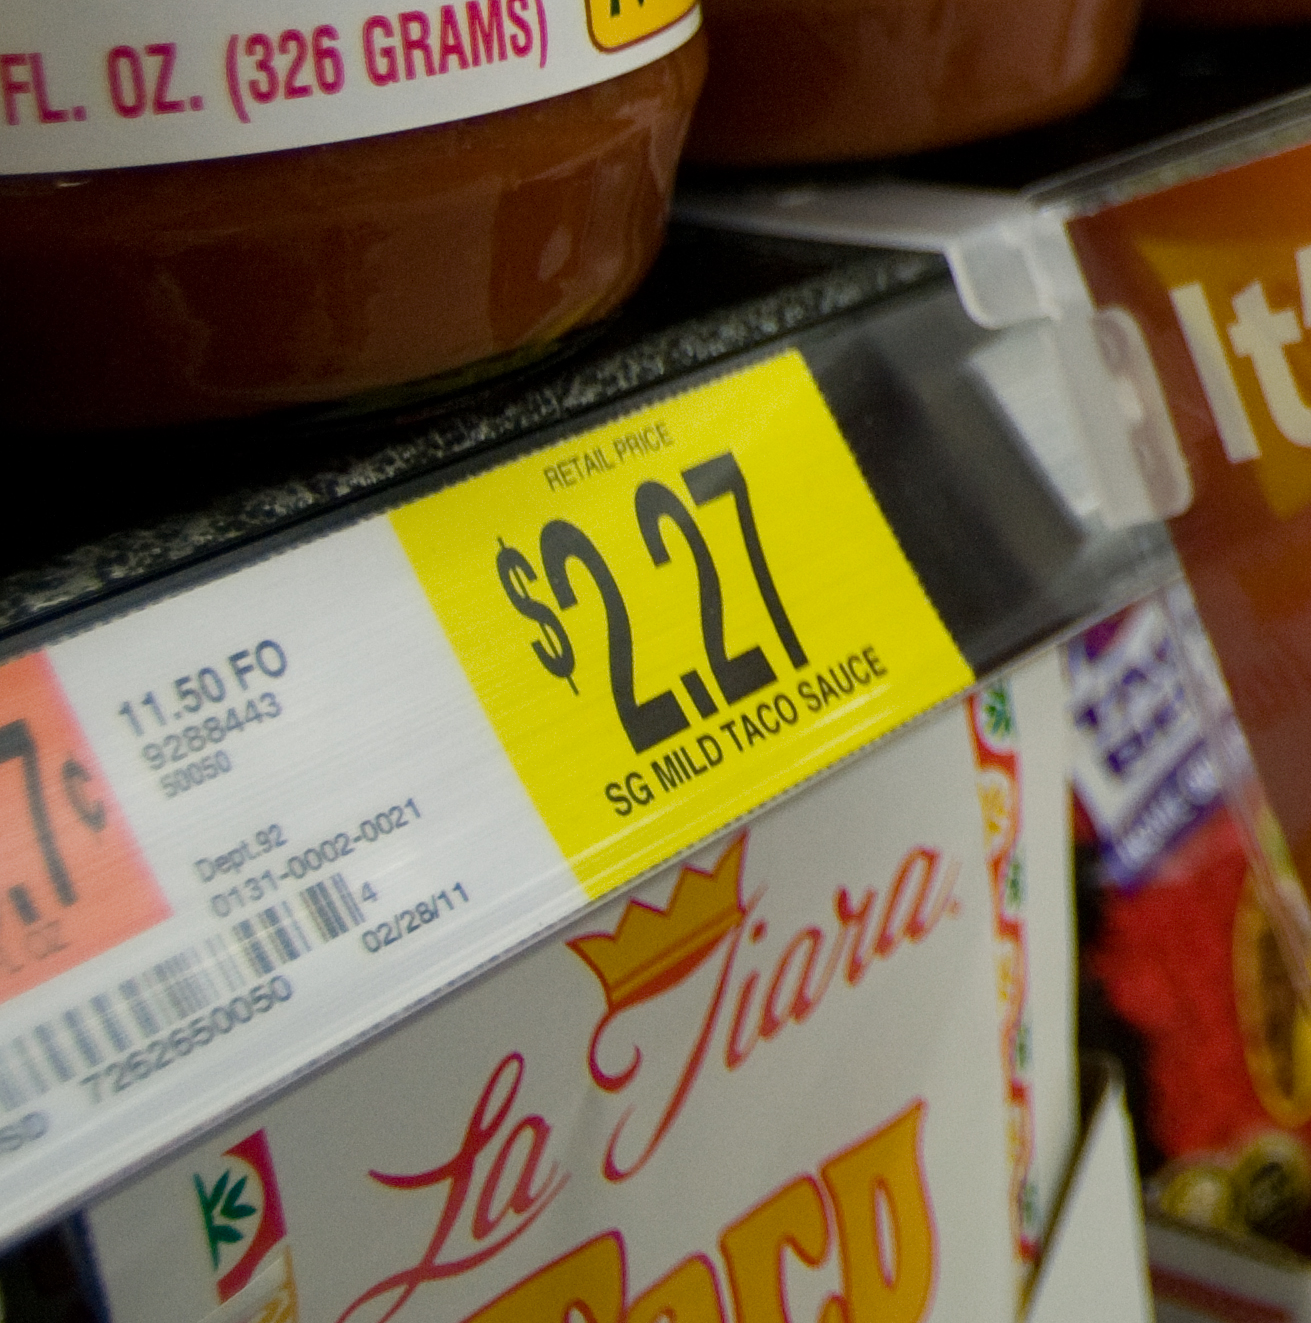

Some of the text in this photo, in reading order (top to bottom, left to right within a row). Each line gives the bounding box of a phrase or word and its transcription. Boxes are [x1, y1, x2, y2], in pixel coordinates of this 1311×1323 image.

[0, 51, 88, 127] FL.
[106, 41, 205, 120] OZ.
[224, 23, 347, 124] (326
[543, 421, 674, 492] RETAIL PRICE
[496, 449, 810, 755] $2.27
[118, 639, 289, 738] 11.50 FO
[141, 691, 283, 772] 9288443
[604, 646, 889, 817] SG MILD TACO SAUCE
[159, 749, 232, 800] 50050
[210, 797, 422, 918] 0131-0002-0021
[360, 881, 378, 903] 4
[360, 881, 470, 954] 02/28/11
